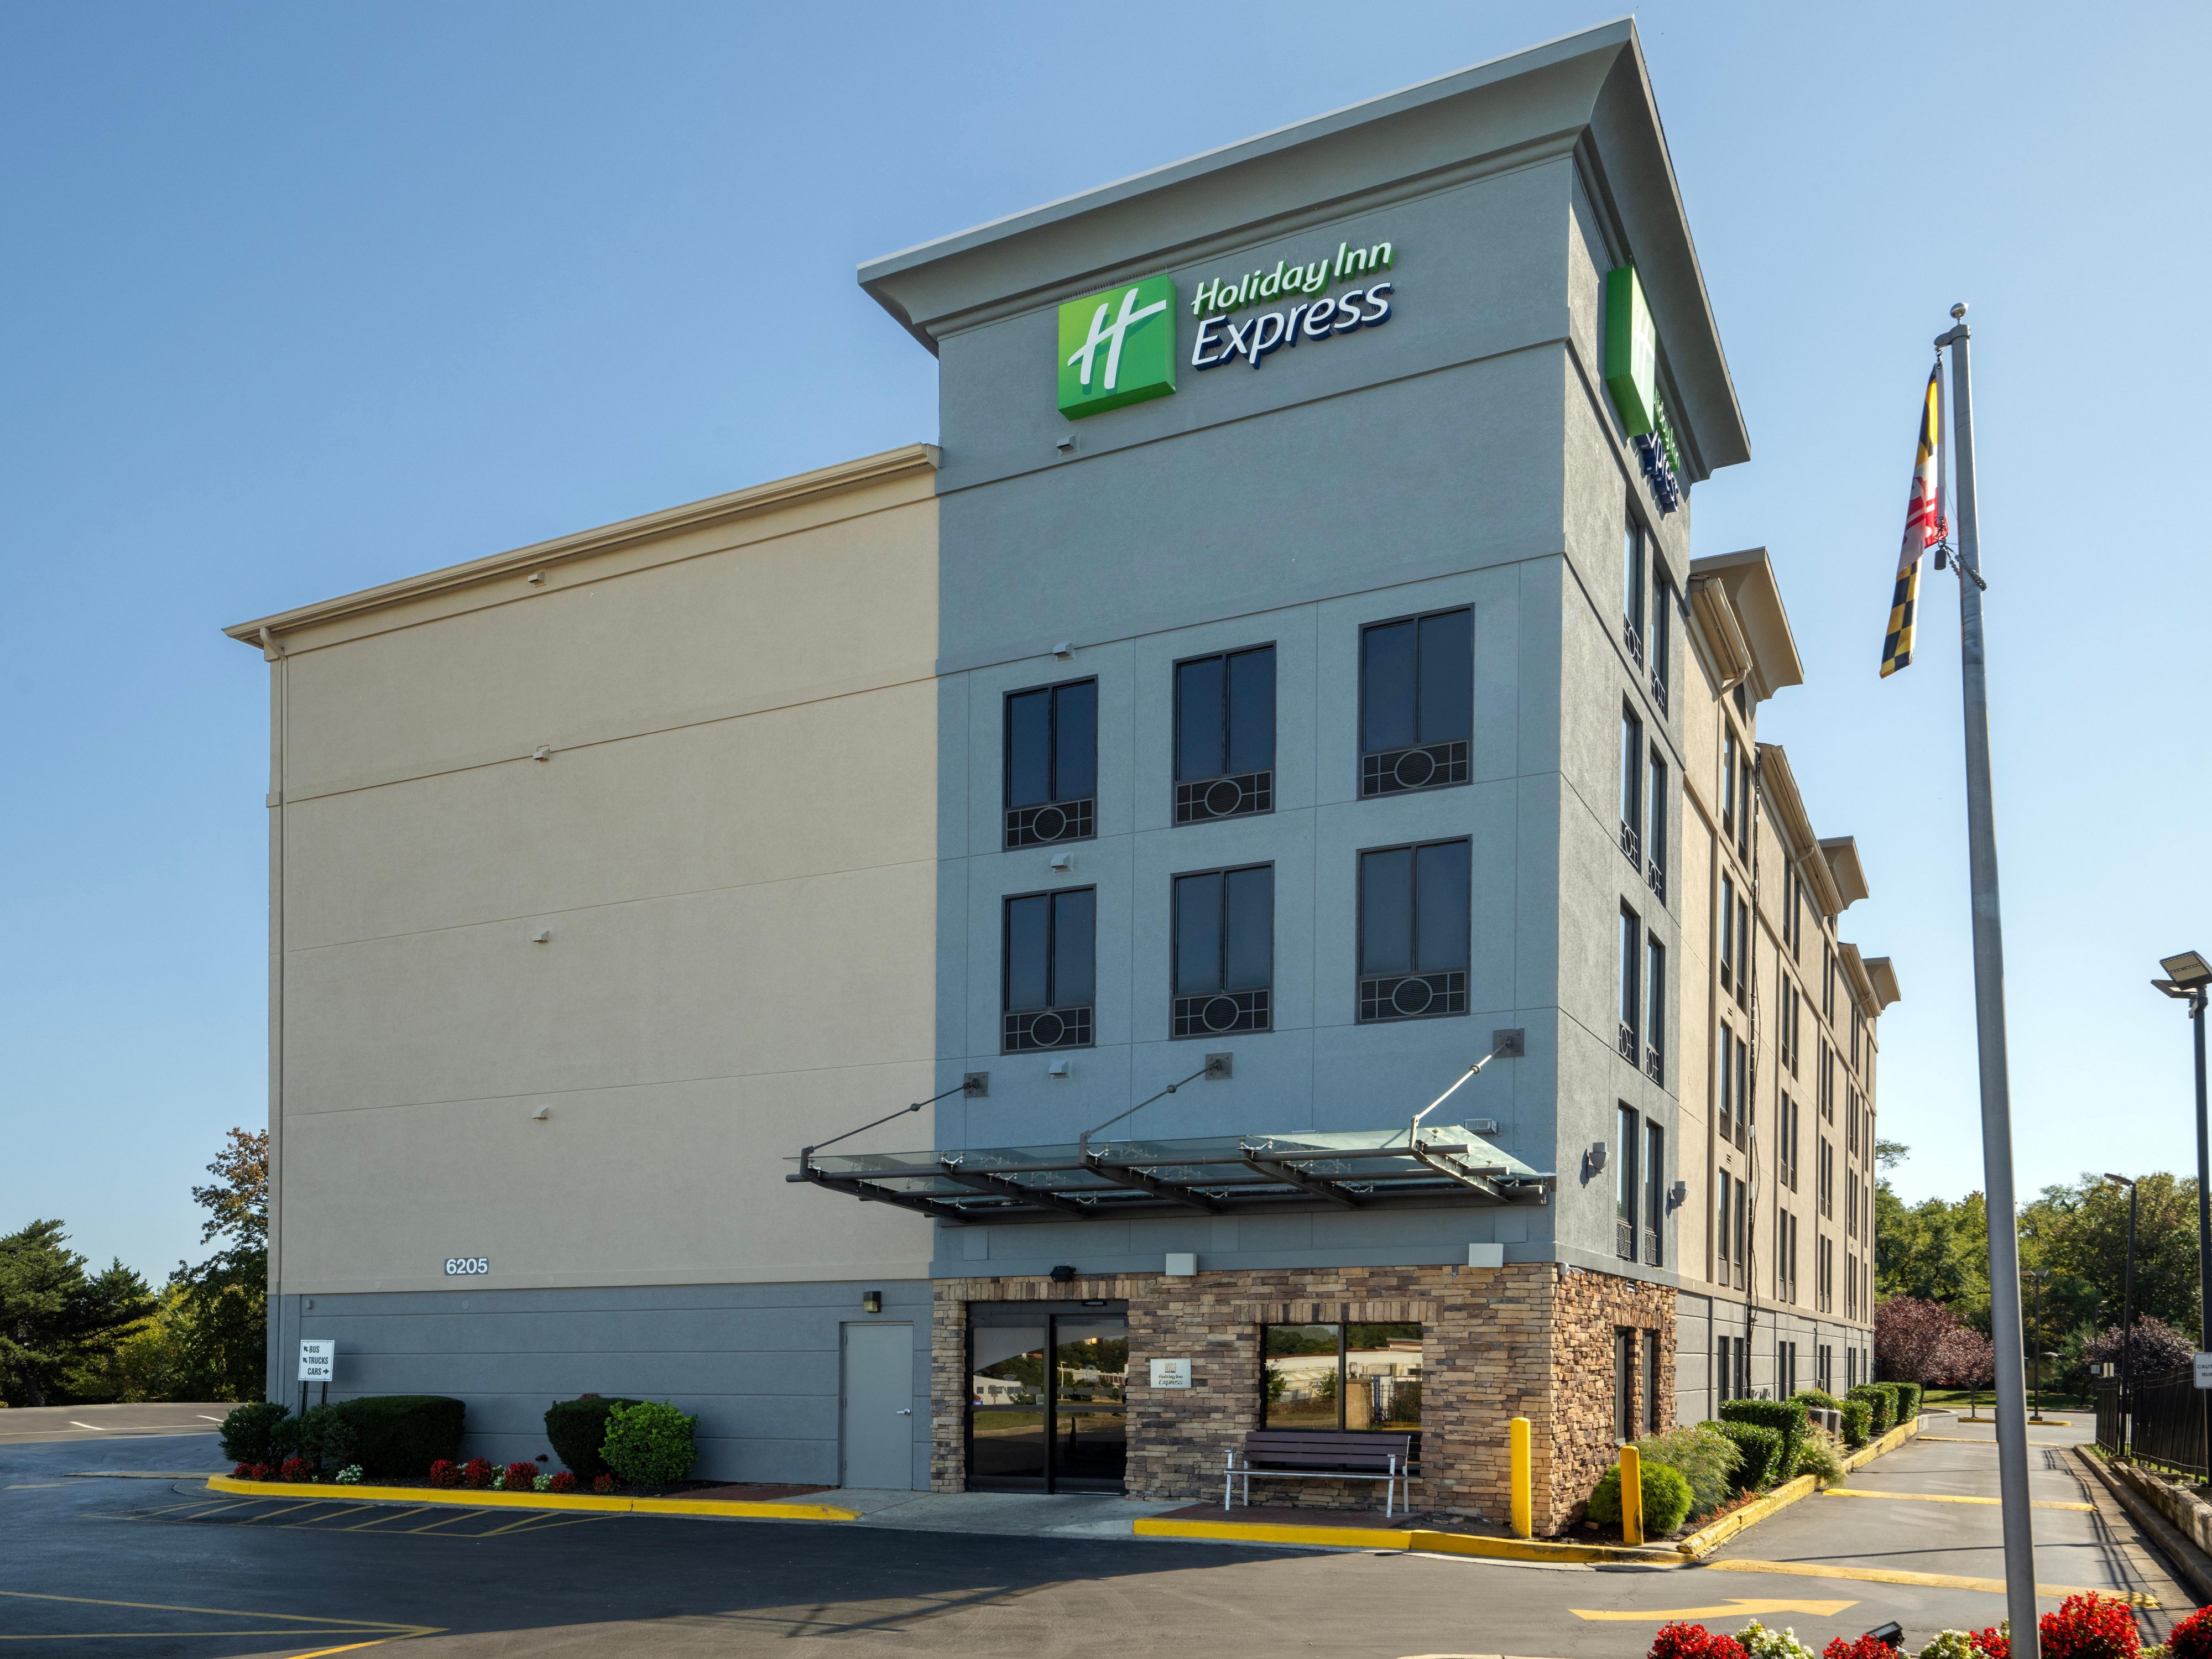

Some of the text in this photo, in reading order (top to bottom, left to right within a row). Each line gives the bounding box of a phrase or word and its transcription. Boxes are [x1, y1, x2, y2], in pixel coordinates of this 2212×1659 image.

[1191, 242, 1393, 317] Holiday Inn
[1191, 283, 1393, 368] Express
[446, 1258, 488, 1274] 6205
